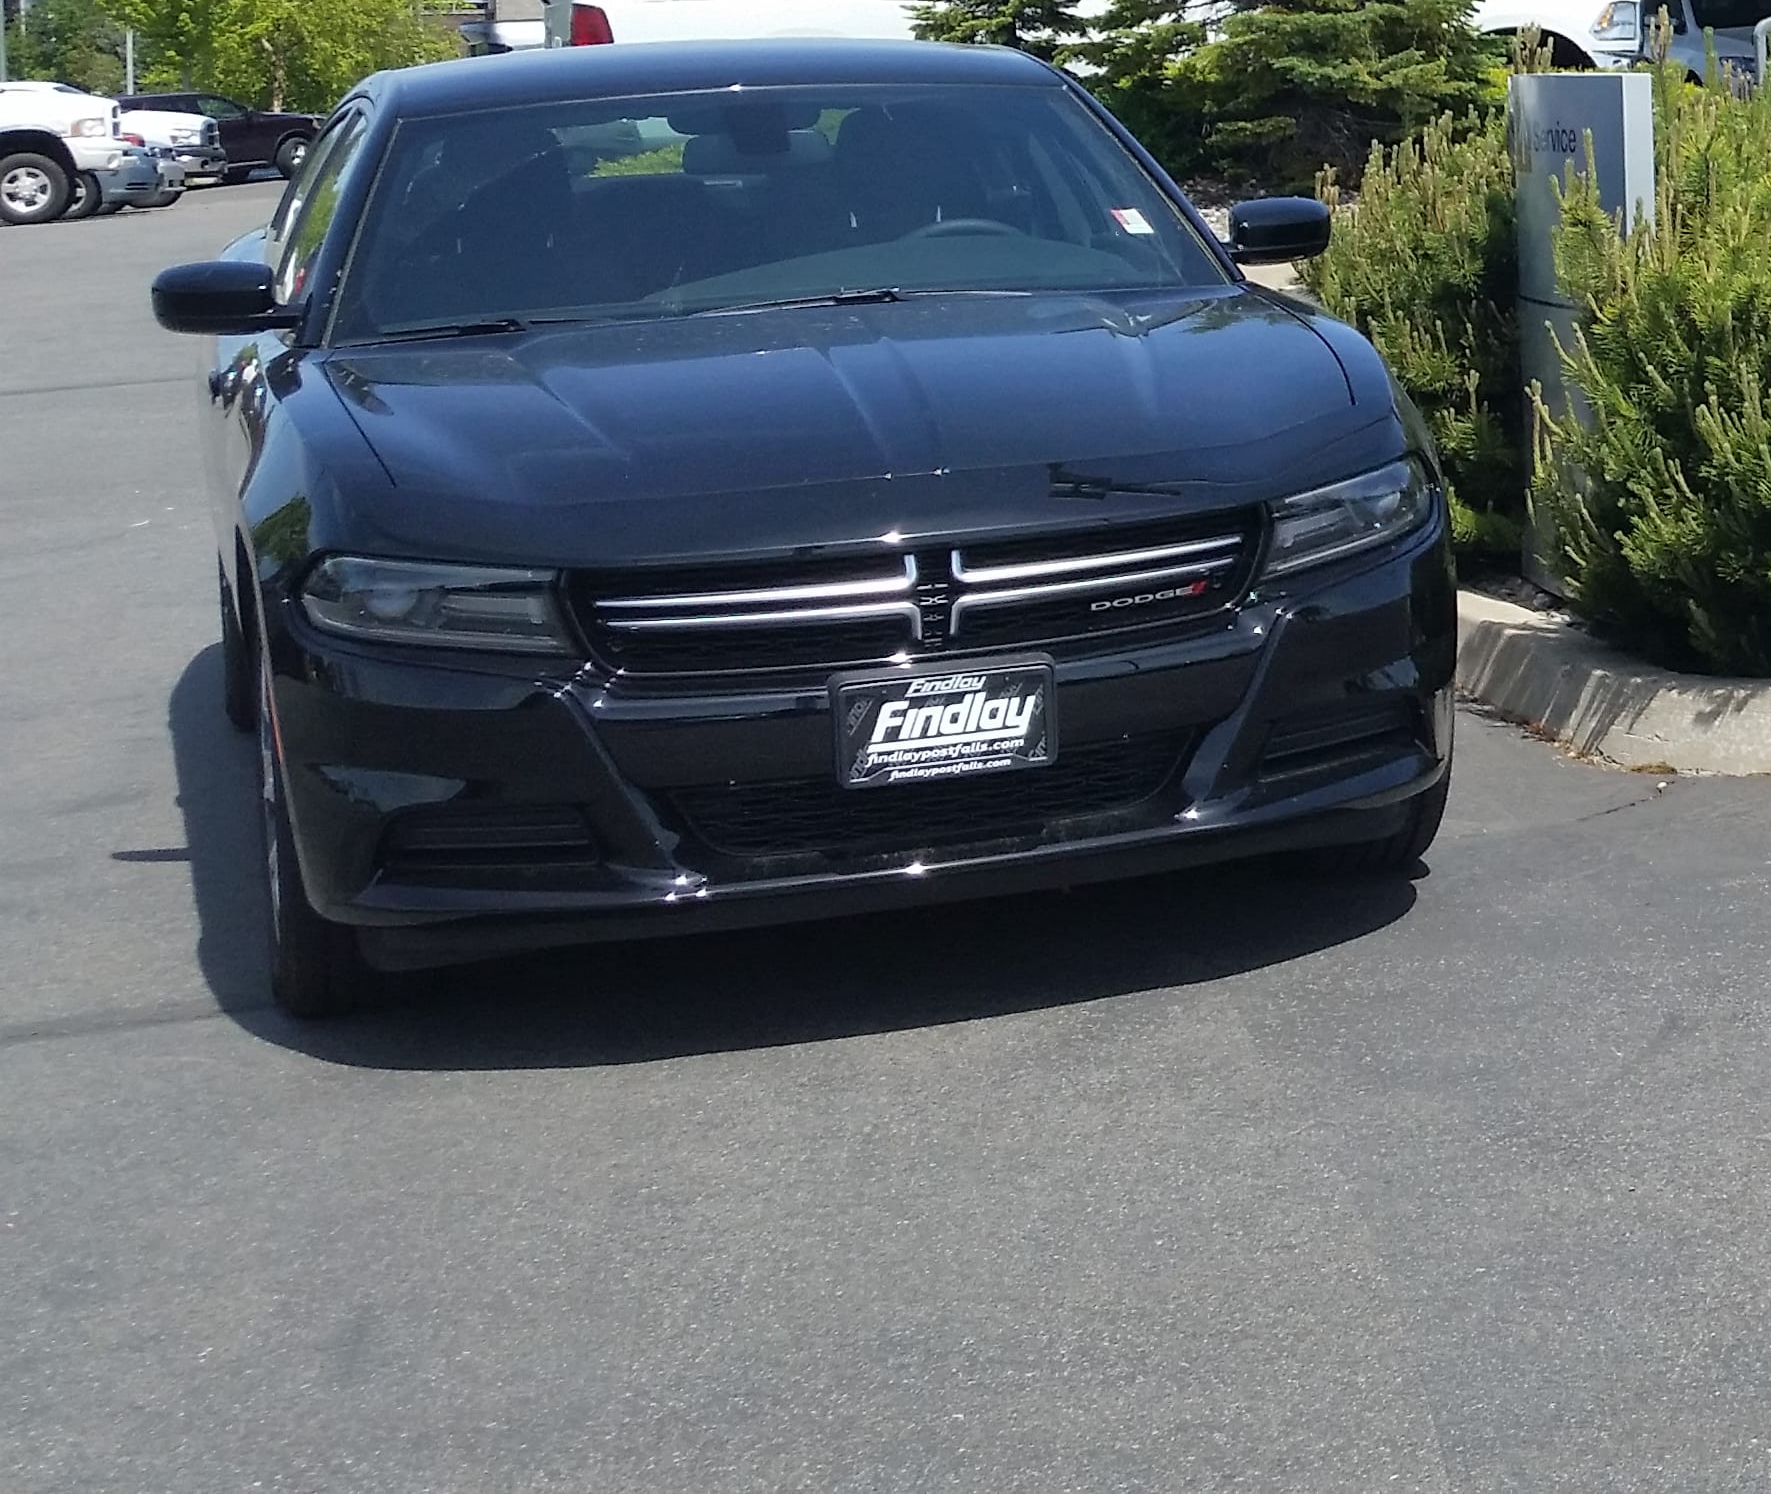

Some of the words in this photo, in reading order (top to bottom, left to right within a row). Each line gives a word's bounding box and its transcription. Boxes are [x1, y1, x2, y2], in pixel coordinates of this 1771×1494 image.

[1533, 120, 1577, 153] Service
[1090, 585, 1194, 611] DODGE
[906, 675, 987, 696] Findlay
[868, 692, 1036, 746] Findlay
[865, 738, 1025, 768] findlaypostfalls.com
[888, 758, 1012, 782] findlaypostfalls.com
